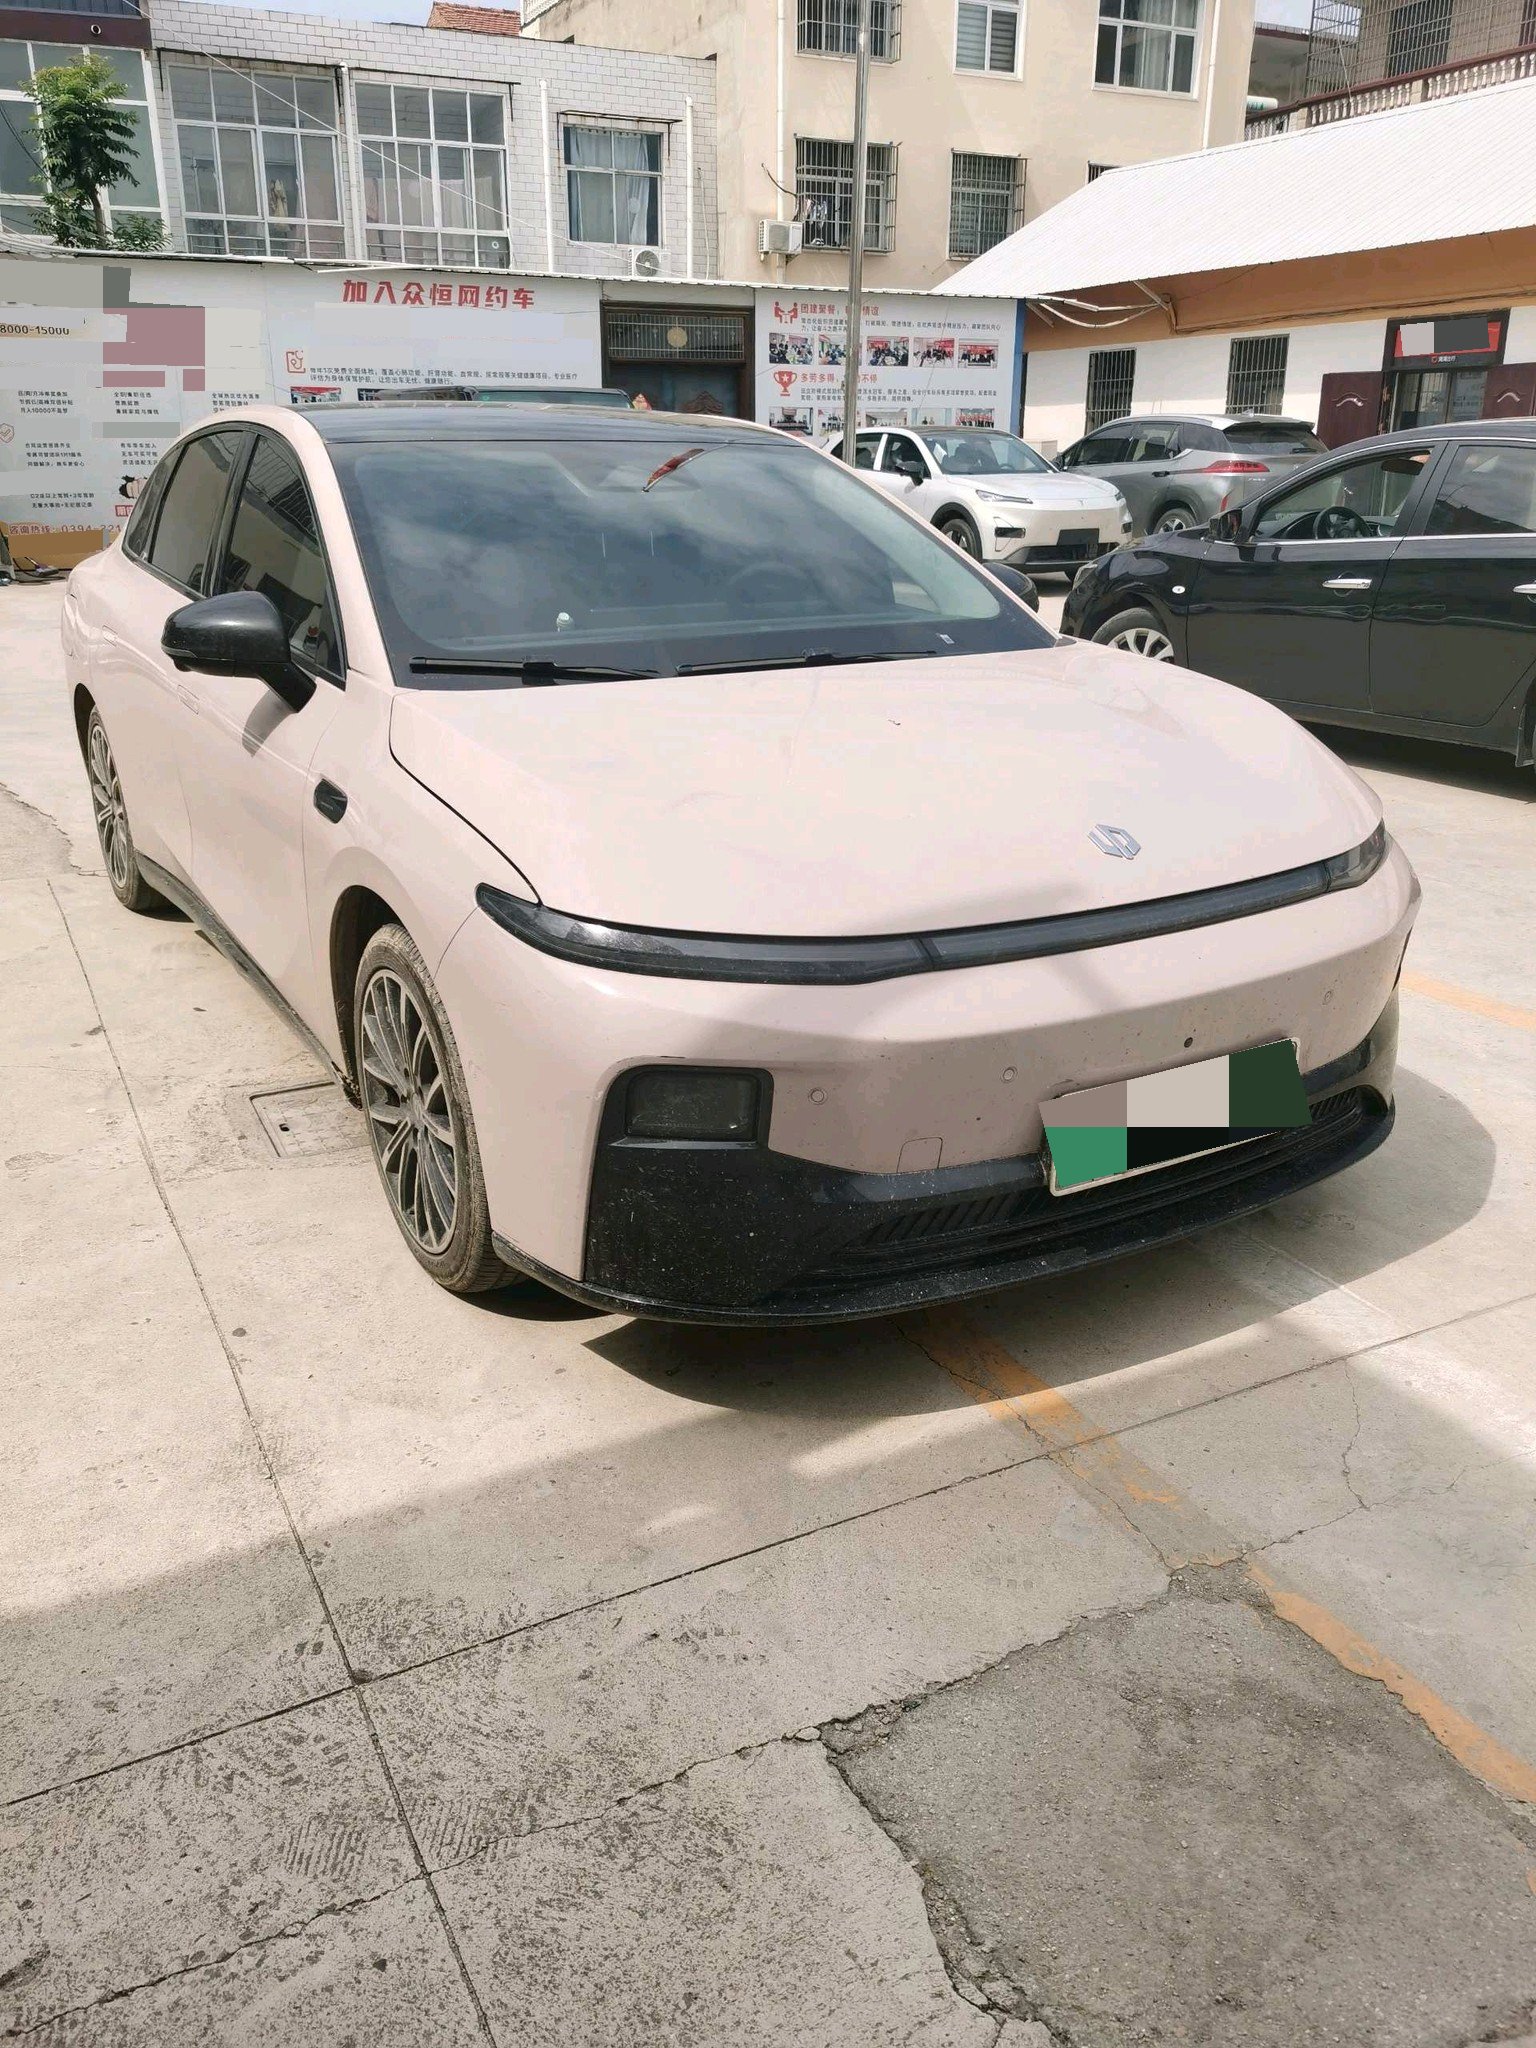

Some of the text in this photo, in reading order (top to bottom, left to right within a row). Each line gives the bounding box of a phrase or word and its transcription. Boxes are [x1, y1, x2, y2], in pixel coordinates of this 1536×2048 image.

[342, 279, 535, 309] 加入众恒网约车
